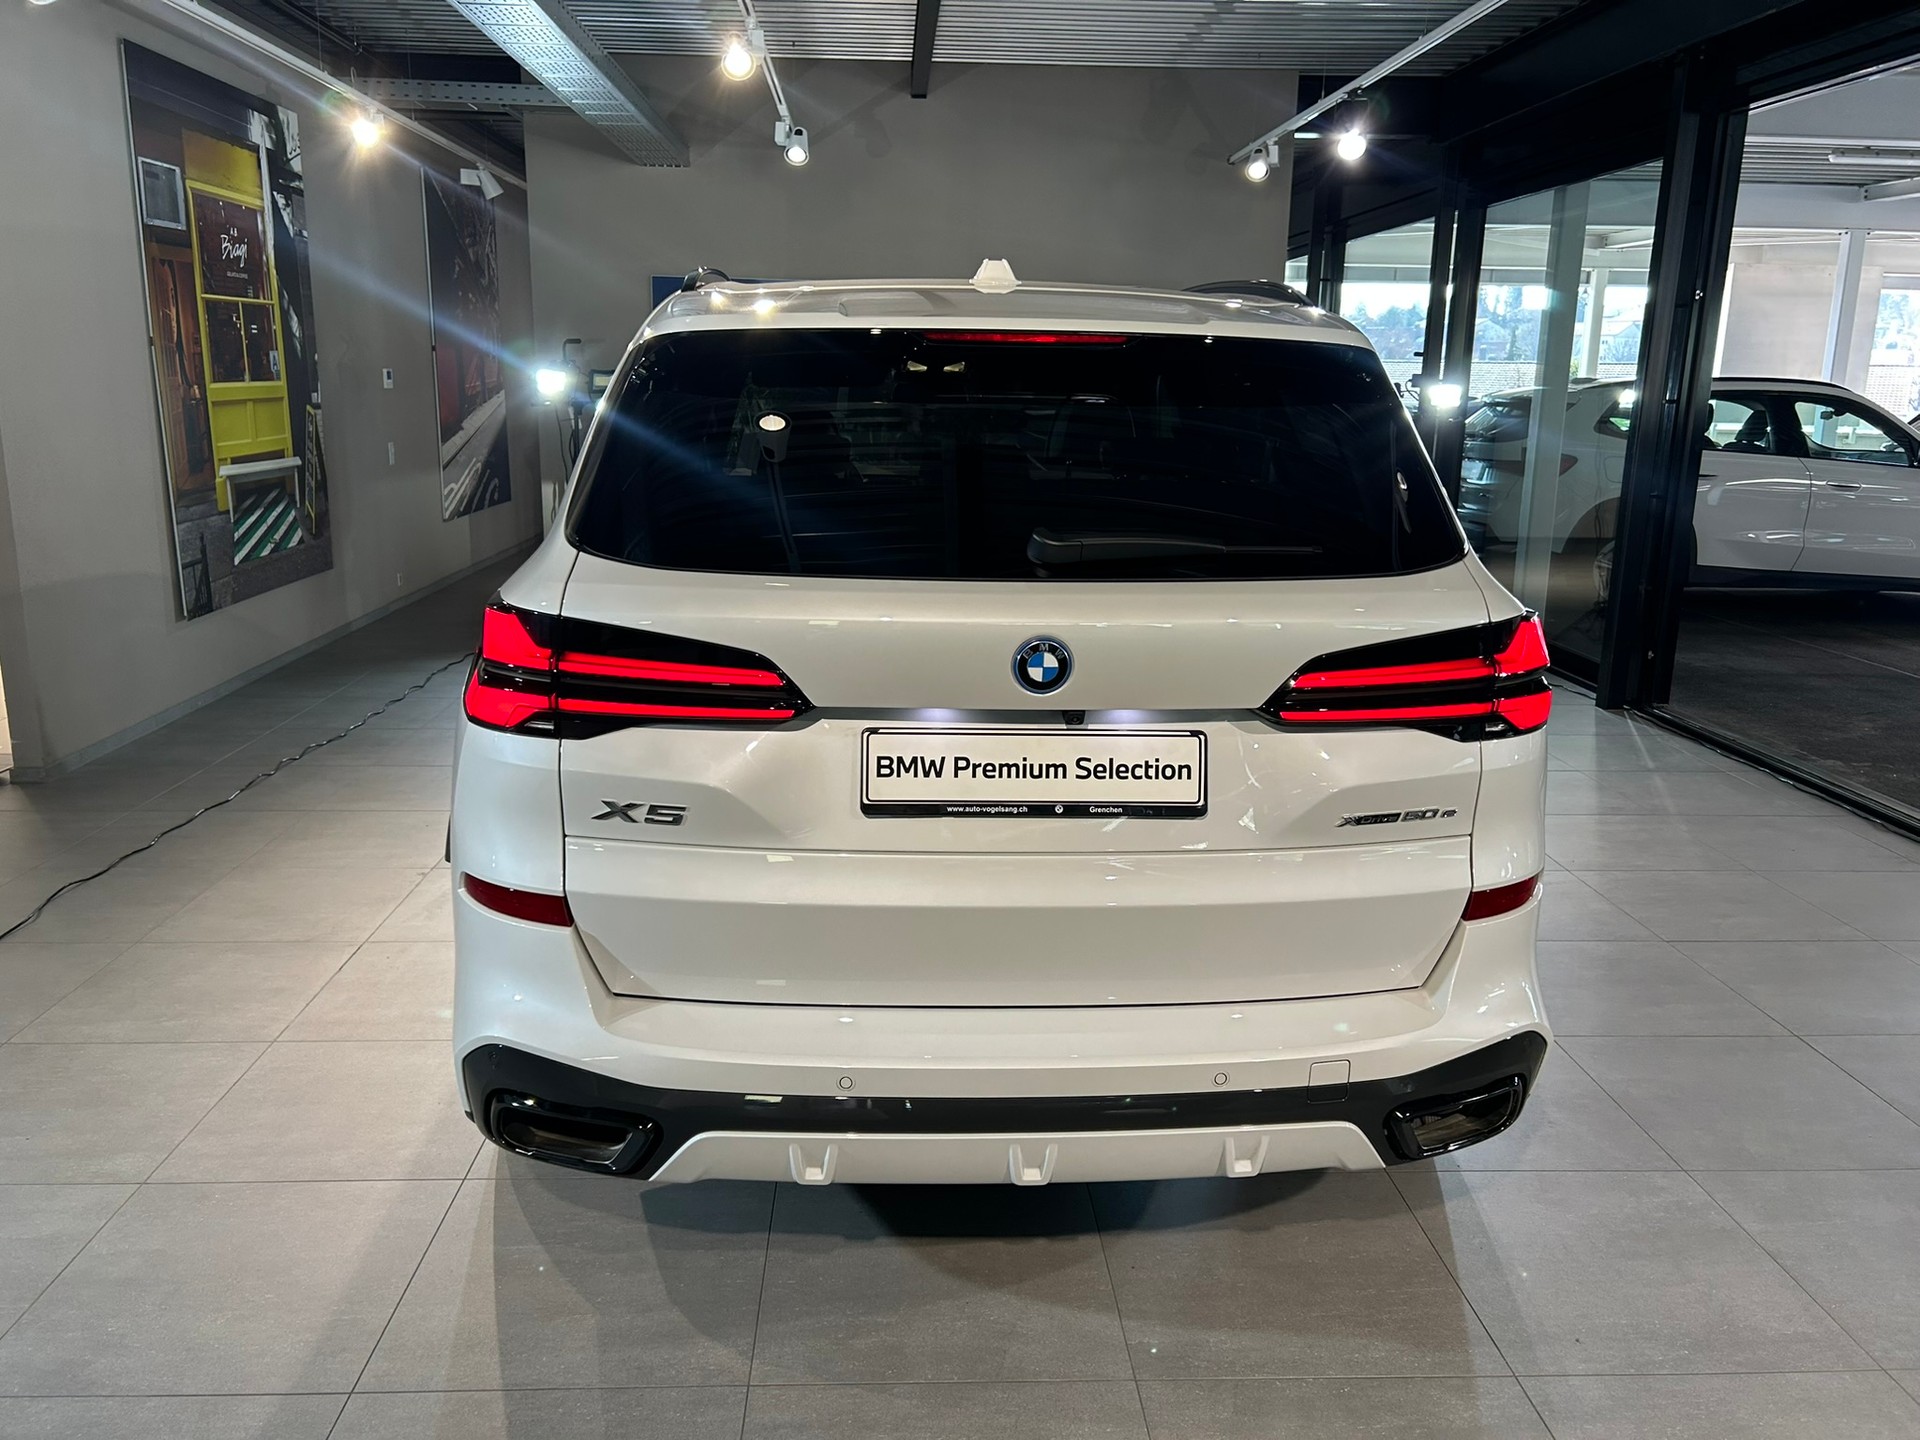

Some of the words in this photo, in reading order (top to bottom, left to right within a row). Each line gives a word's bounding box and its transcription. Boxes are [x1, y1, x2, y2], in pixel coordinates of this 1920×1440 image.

[220, 235, 248, 268] Biagi
[1023, 643, 1065, 660] BMW
[876, 756, 946, 779] BMW
[953, 756, 1067, 780] Premium
[1075, 757, 1193, 781] Selection
[591, 798, 690, 827] X5
[946, 804, 1028, 814] www.auto-vogelsang.ch
[1089, 805, 1123, 814] Grenchen
